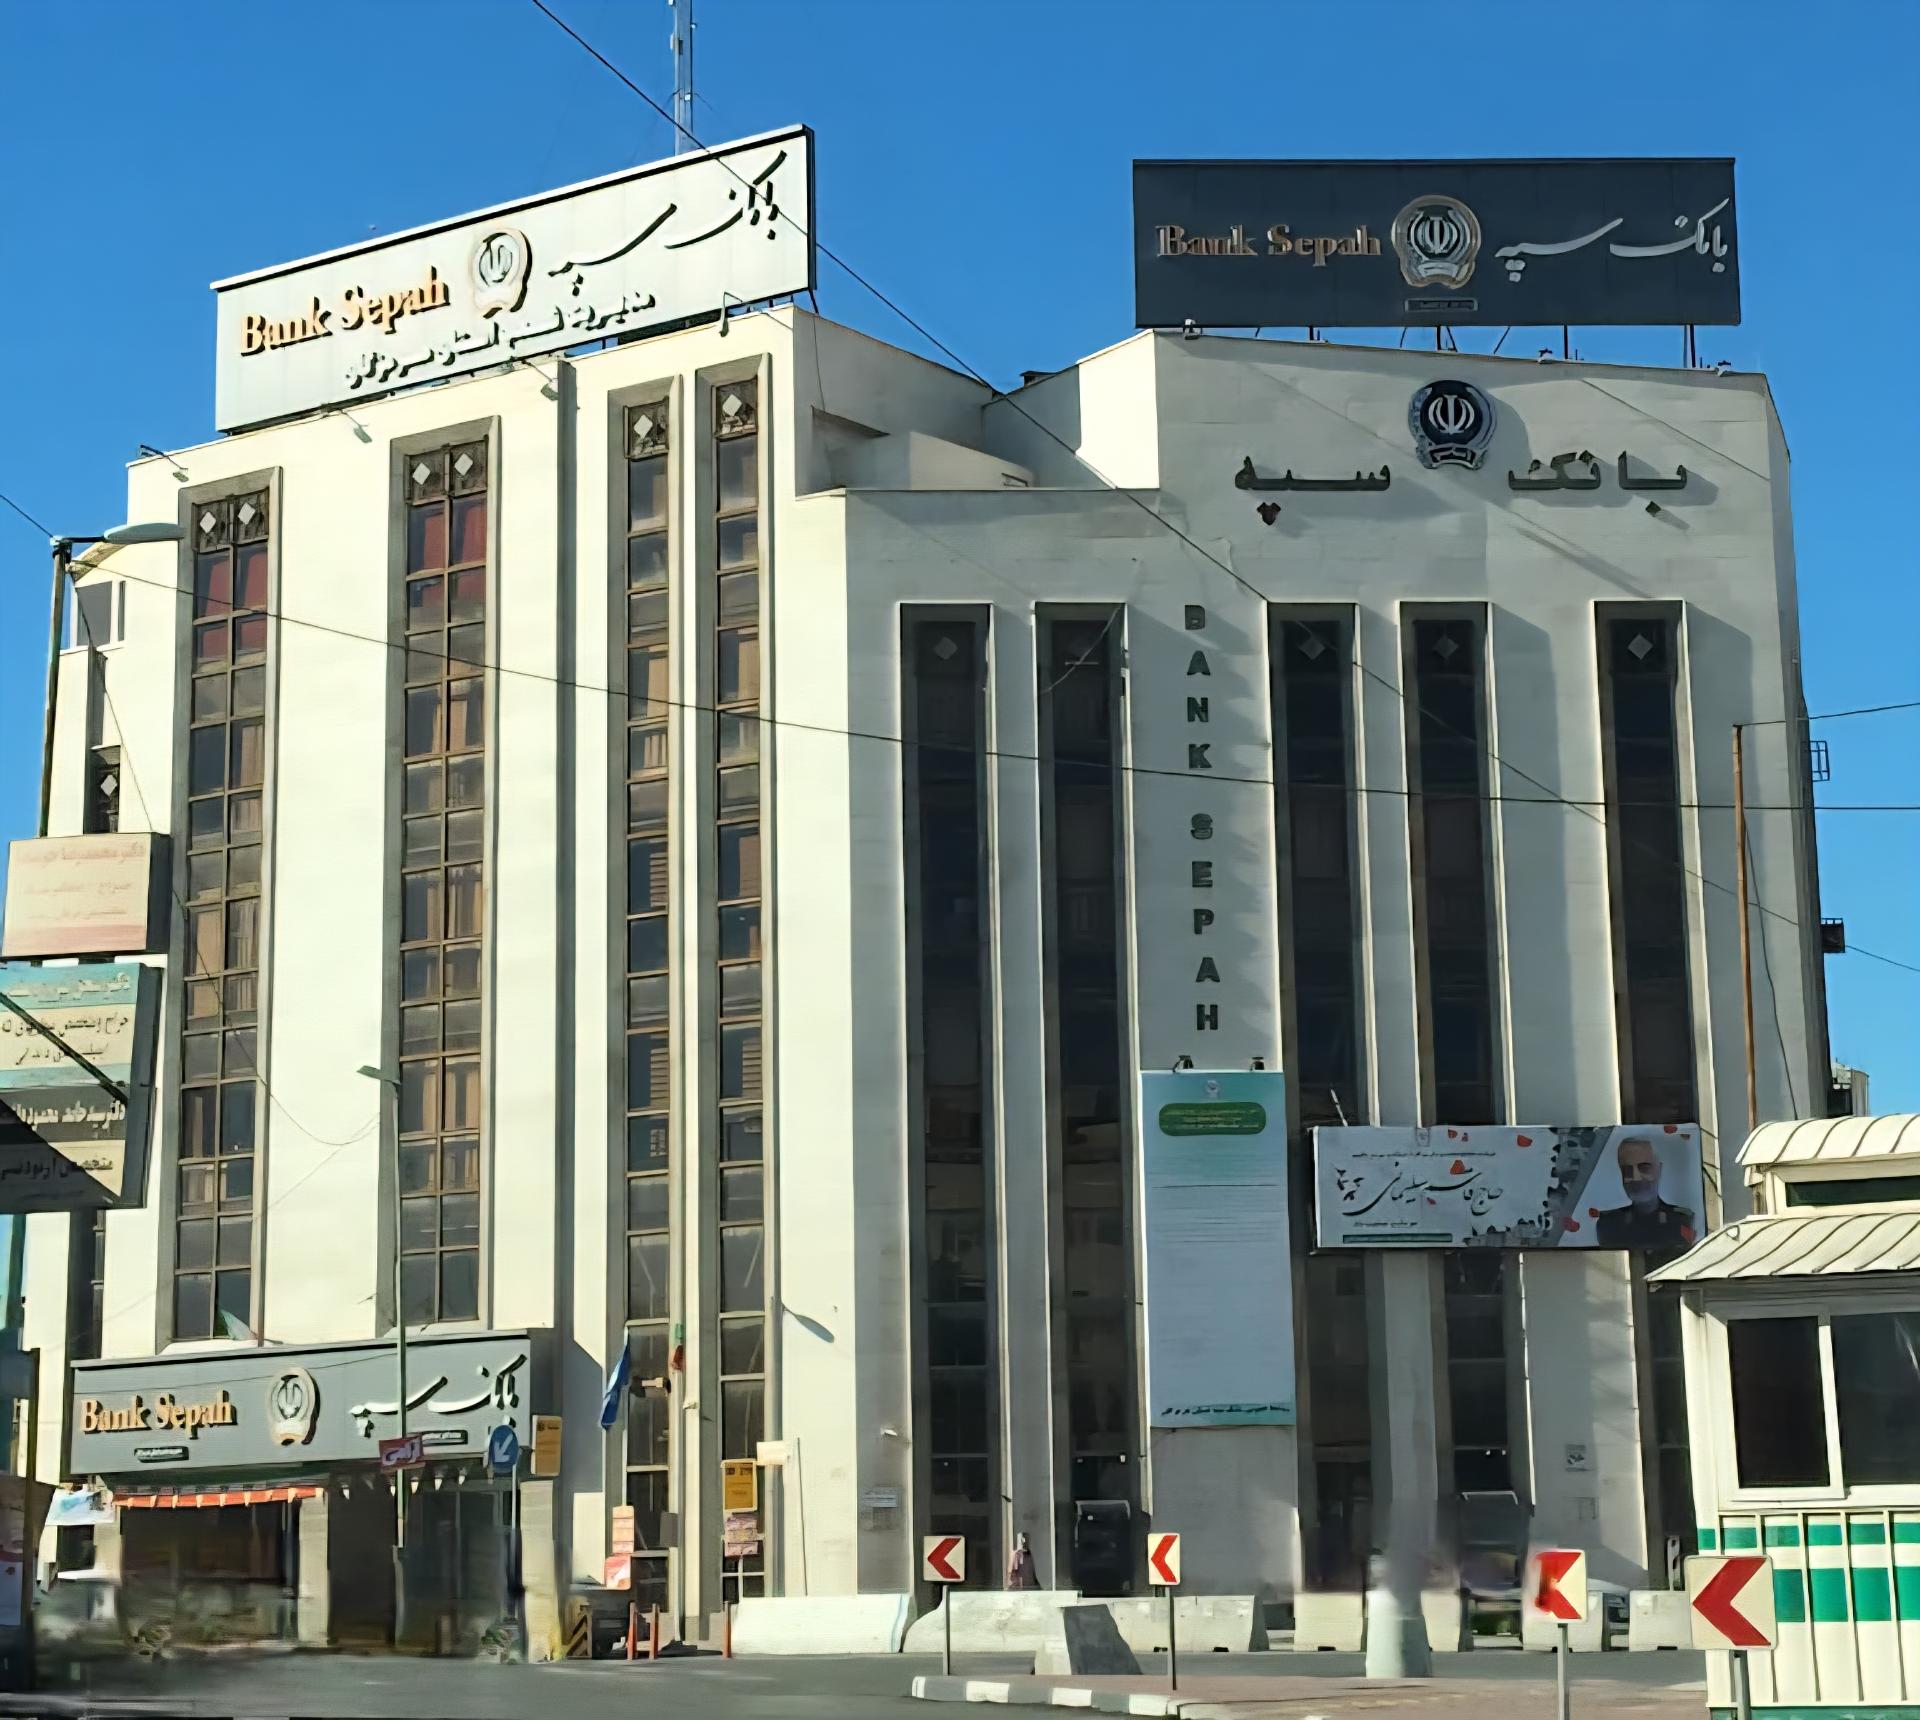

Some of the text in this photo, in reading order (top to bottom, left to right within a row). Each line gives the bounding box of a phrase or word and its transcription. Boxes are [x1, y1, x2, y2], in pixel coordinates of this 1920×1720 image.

[665, 150, 787, 248] بانک
[1155, 224, 1383, 268] Bank Sepah
[1495, 197, 1730, 283] بانک سپه
[239, 266, 450, 356] Bank Sepah
[1508, 449, 1688, 517] بانک
[1184, 604, 1221, 1031] BANK SEPAH
[79, 1386, 238, 1440] Bank Sepah
[427, 1353, 528, 1429] بانک
